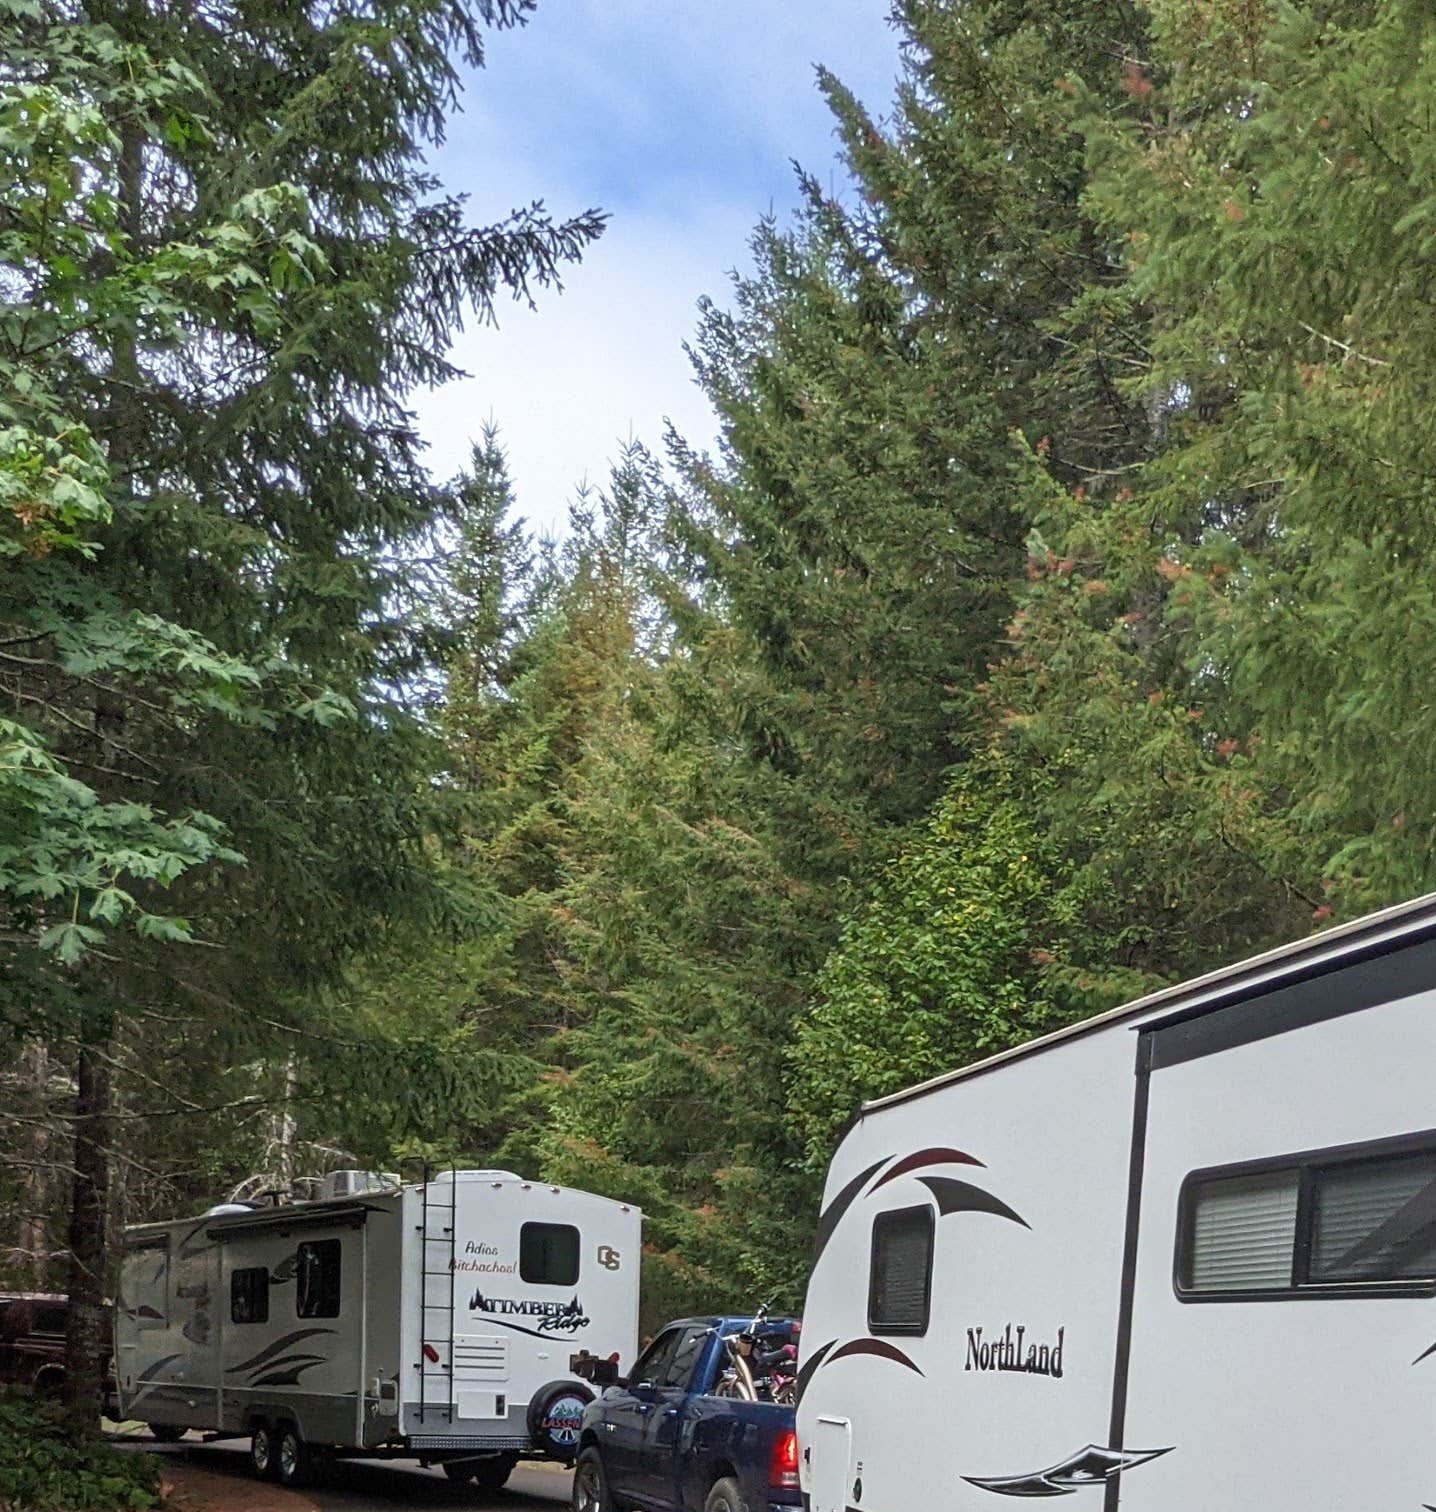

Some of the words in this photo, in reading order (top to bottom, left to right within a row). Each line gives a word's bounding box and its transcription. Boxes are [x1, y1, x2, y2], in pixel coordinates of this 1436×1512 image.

[465, 1240, 499, 1256] Adios
[484, 1297, 571, 1317] TIMBER
[964, 1322, 1065, 1378] NorthLand
